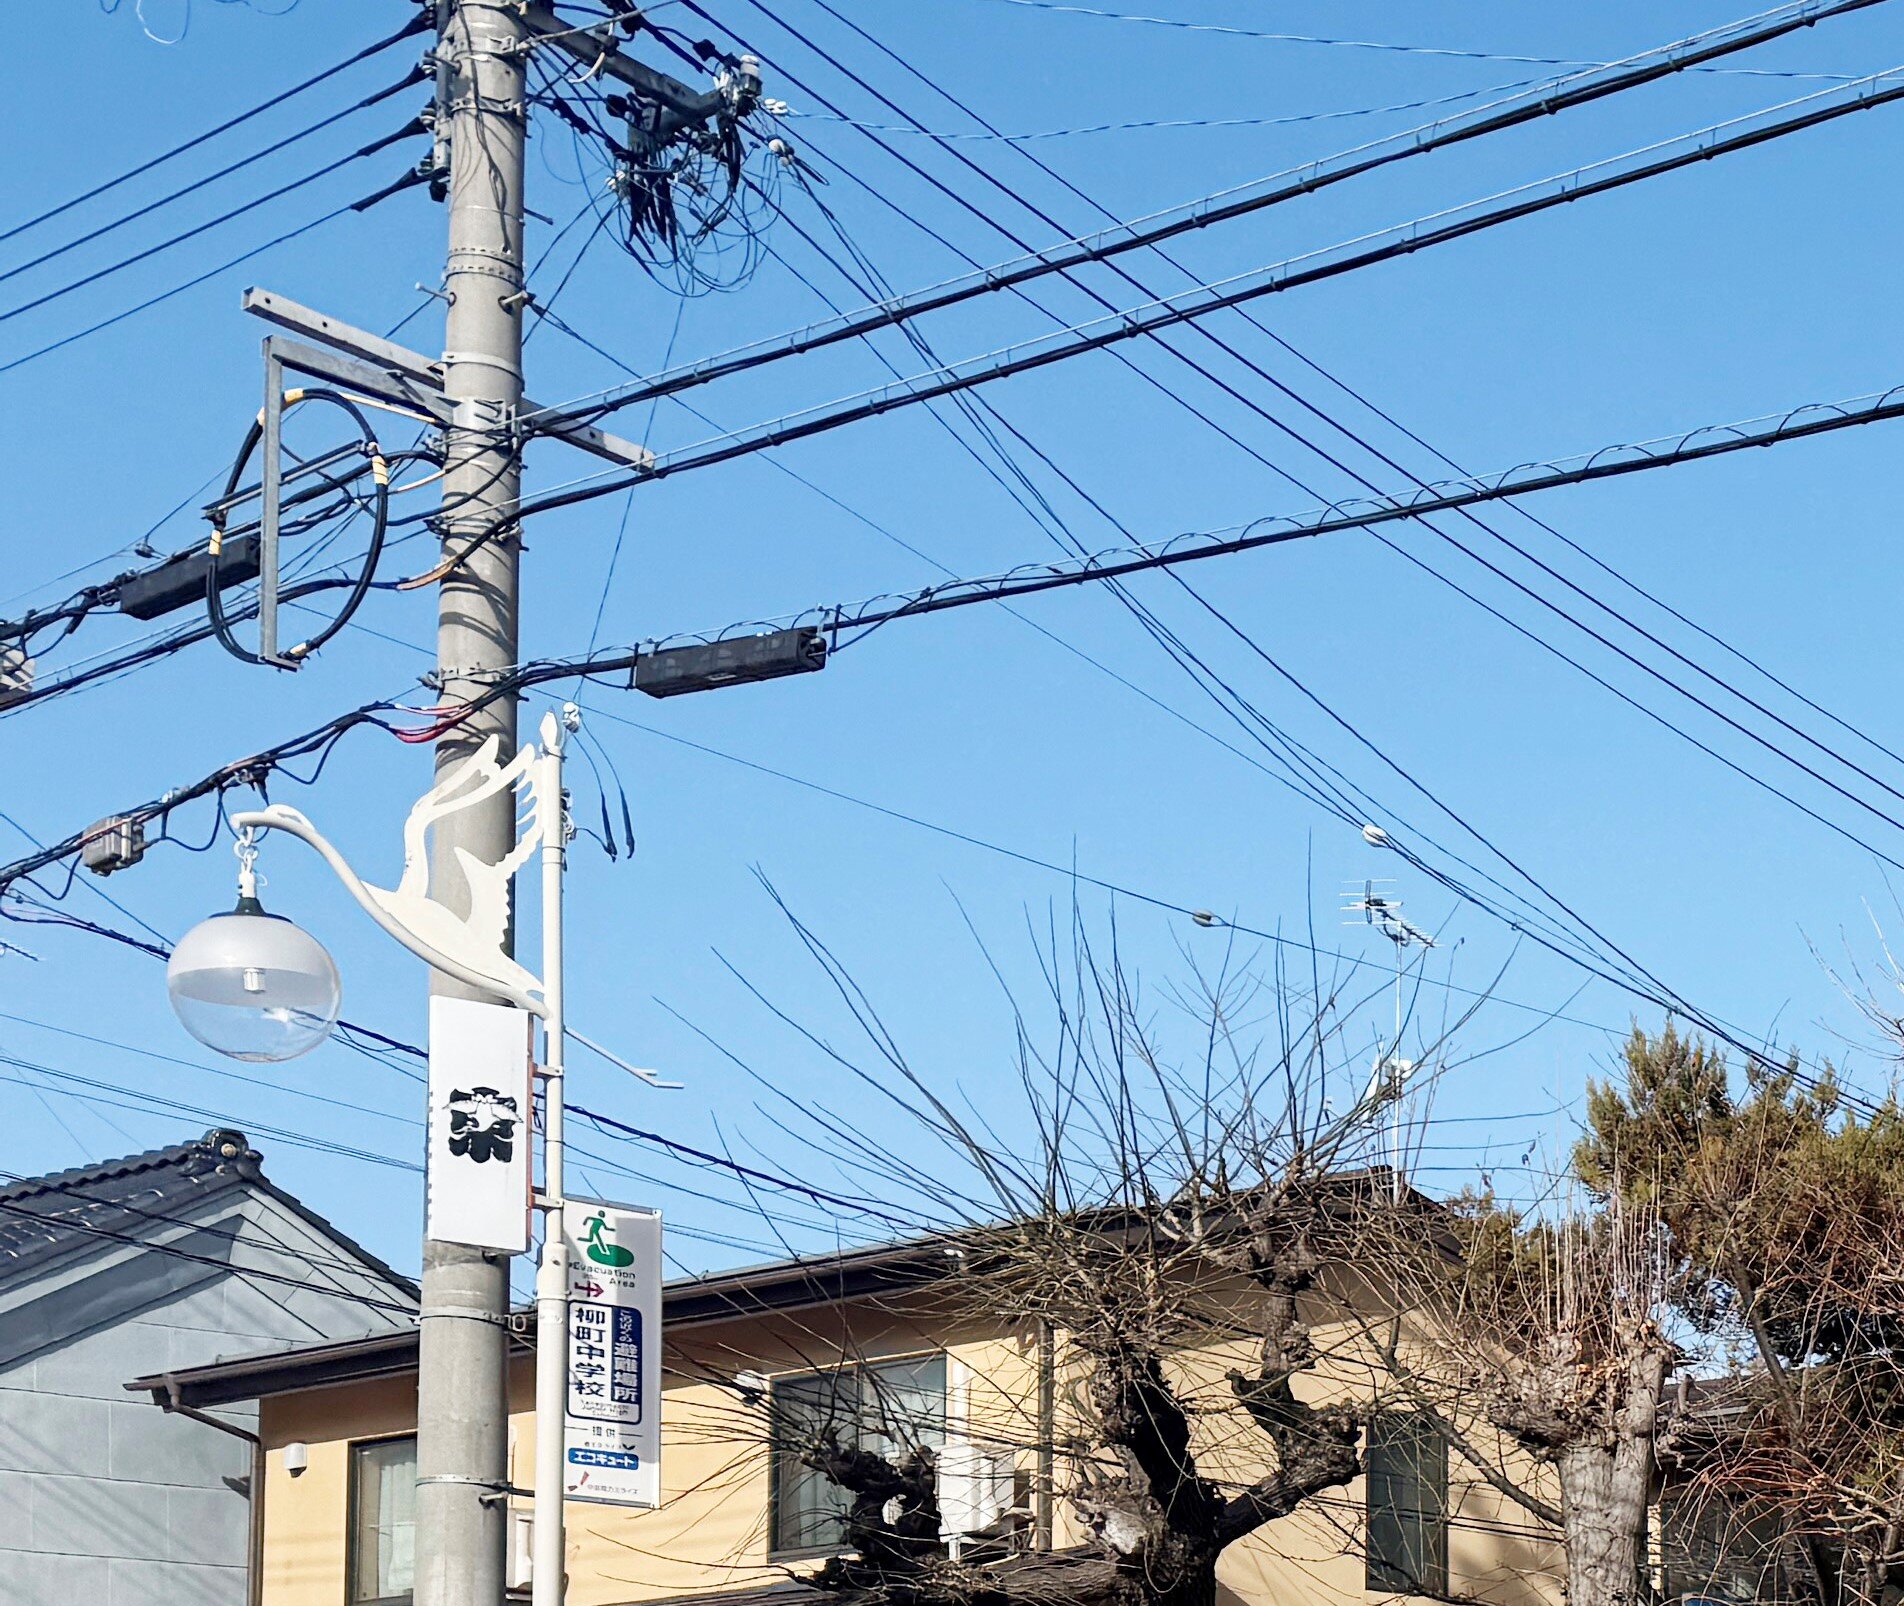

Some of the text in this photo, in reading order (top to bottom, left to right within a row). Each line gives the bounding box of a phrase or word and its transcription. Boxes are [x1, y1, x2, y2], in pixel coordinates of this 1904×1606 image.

[573, 1262, 636, 1280] Evacuation
[609, 1278, 636, 1288] Area
[574, 1307, 606, 1398] 柳町中学校
[574, 1452, 636, 1468] エコキュート
